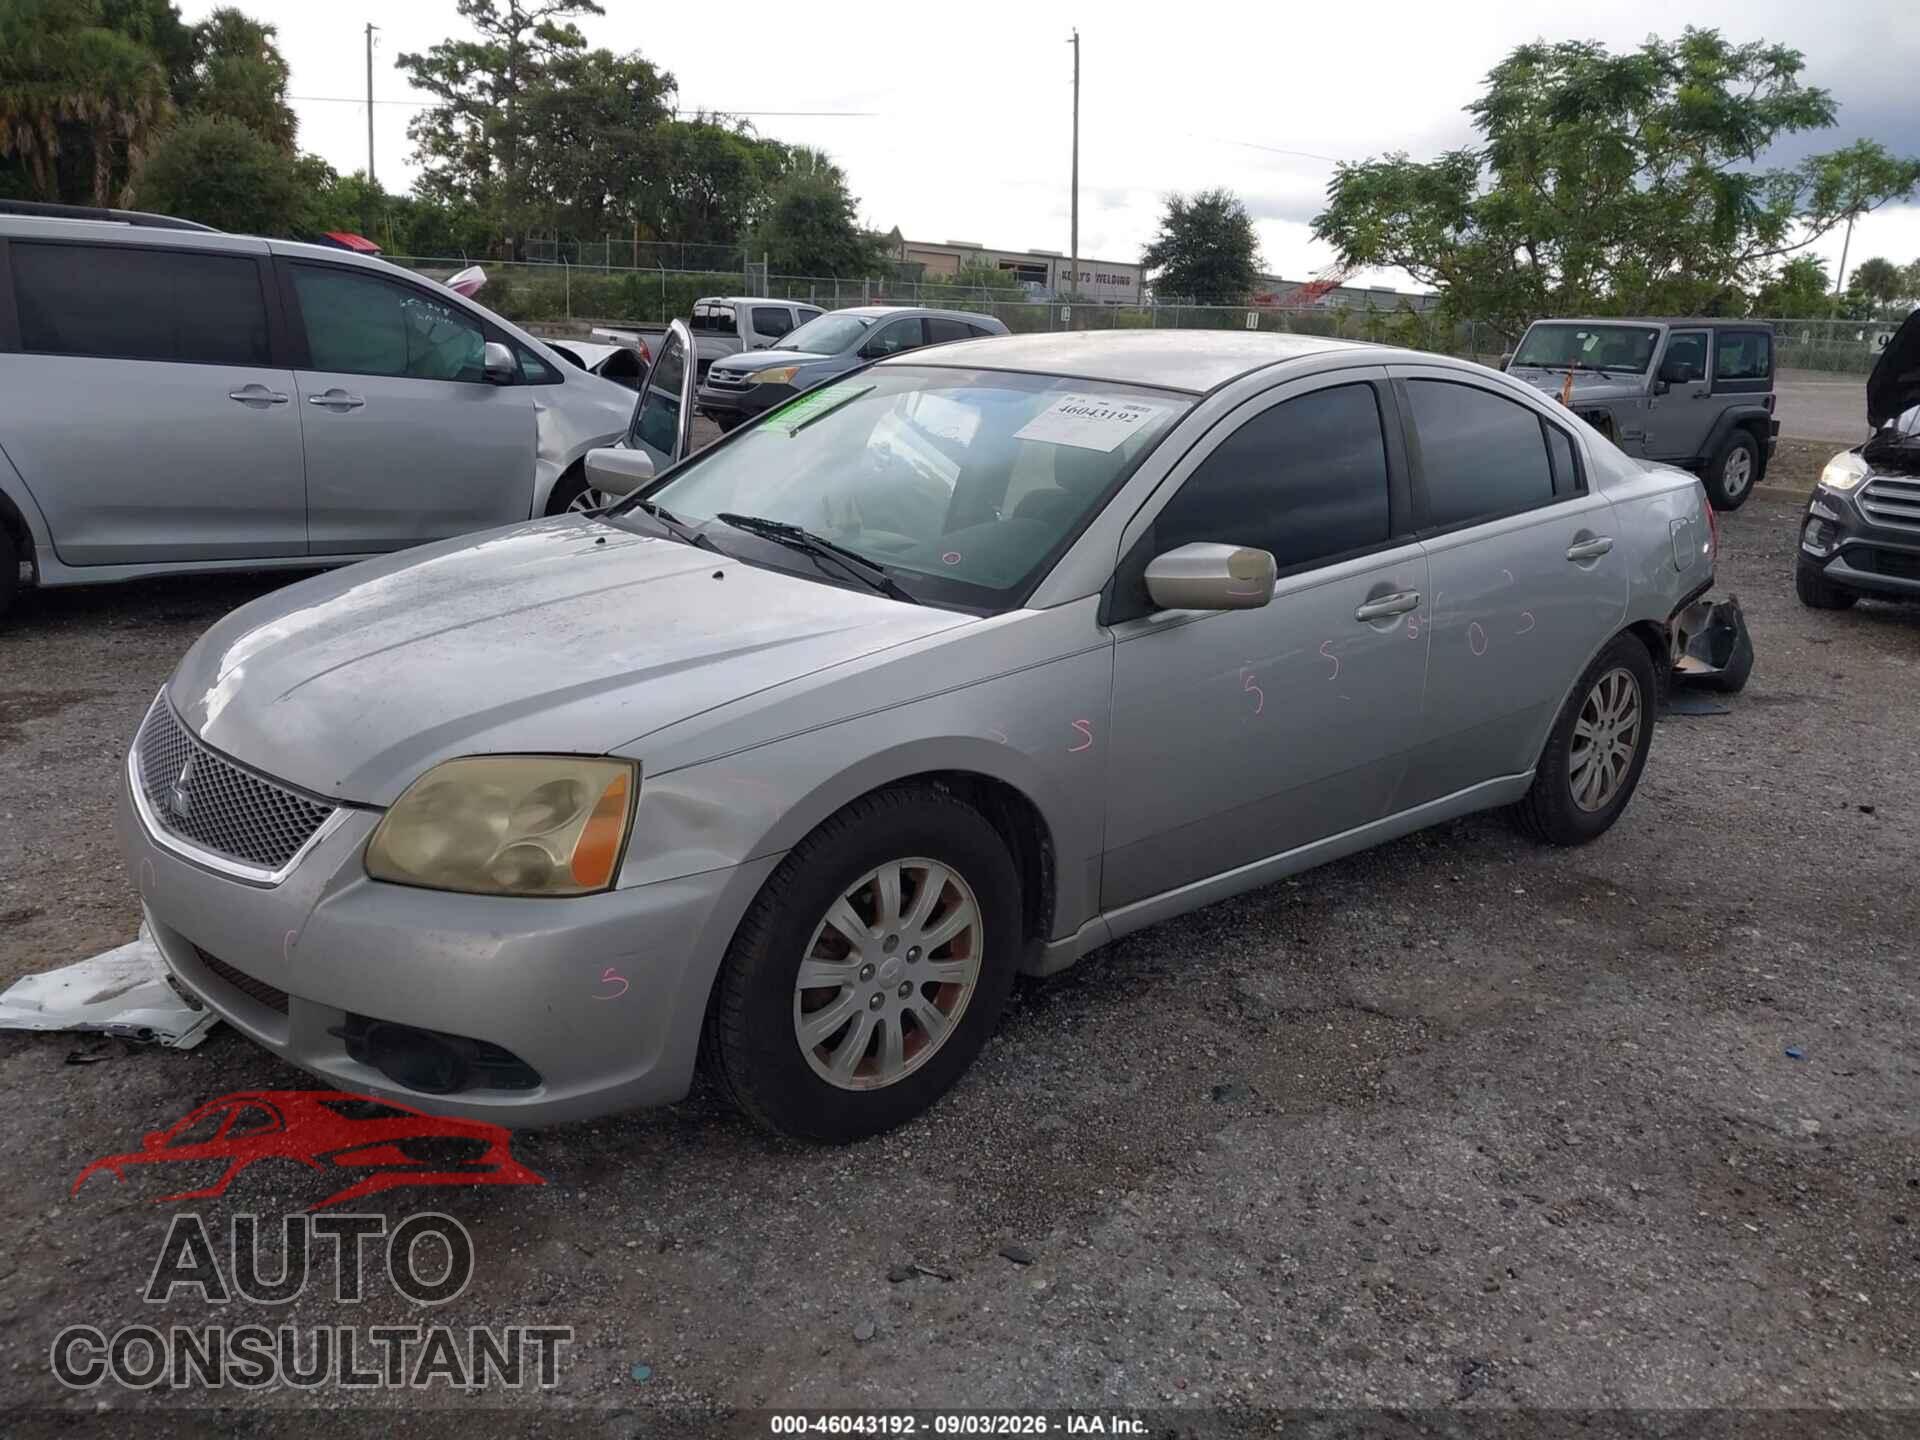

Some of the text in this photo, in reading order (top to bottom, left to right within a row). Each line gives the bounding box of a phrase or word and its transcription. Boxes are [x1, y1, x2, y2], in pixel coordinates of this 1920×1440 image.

[1061, 270, 1131, 286] KEY'S WELDING
[1058, 404, 1139, 423] 46043192
